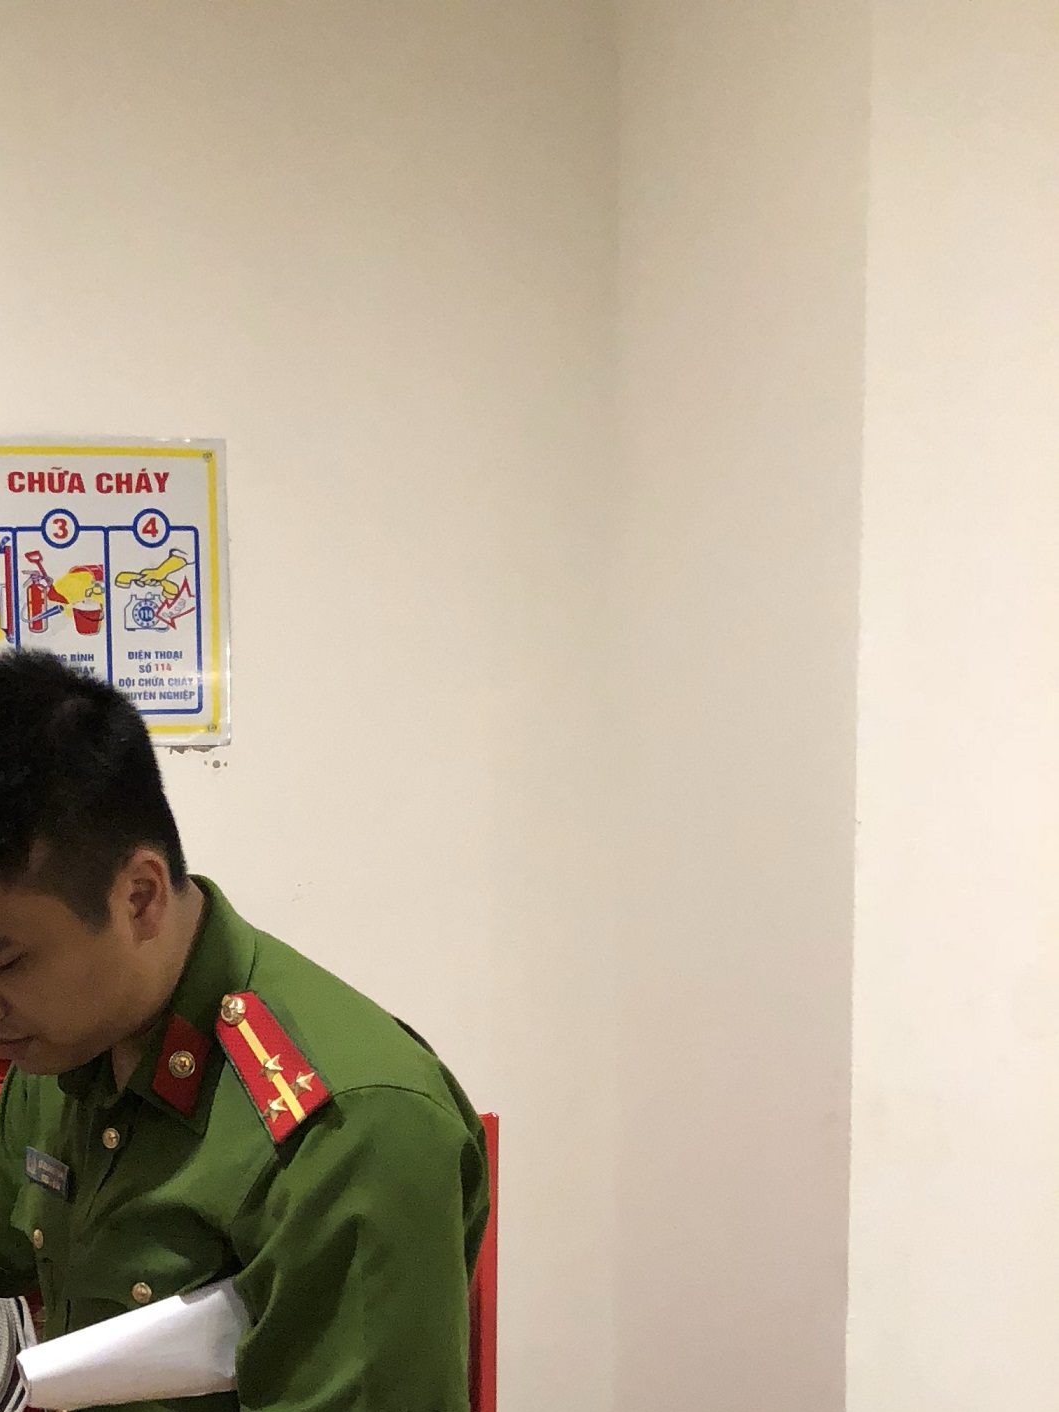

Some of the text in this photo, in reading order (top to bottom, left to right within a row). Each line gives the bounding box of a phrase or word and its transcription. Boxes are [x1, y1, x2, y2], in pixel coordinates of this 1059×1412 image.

[8, 466, 86, 494] CHỮA
[95, 468, 169, 494] CHÁY
[52, 518, 69, 540] 3
[141, 517, 158, 538] 4
[70, 652, 95, 662] BÌNH
[127, 650, 183, 661] ĐIỆN THOẠI
[139, 662, 172, 673] SỐ 114
[118, 677, 135, 688] ĐỘI
[168, 677, 194, 687] CHÁY
[159, 689, 195, 701] NGHIỆP
